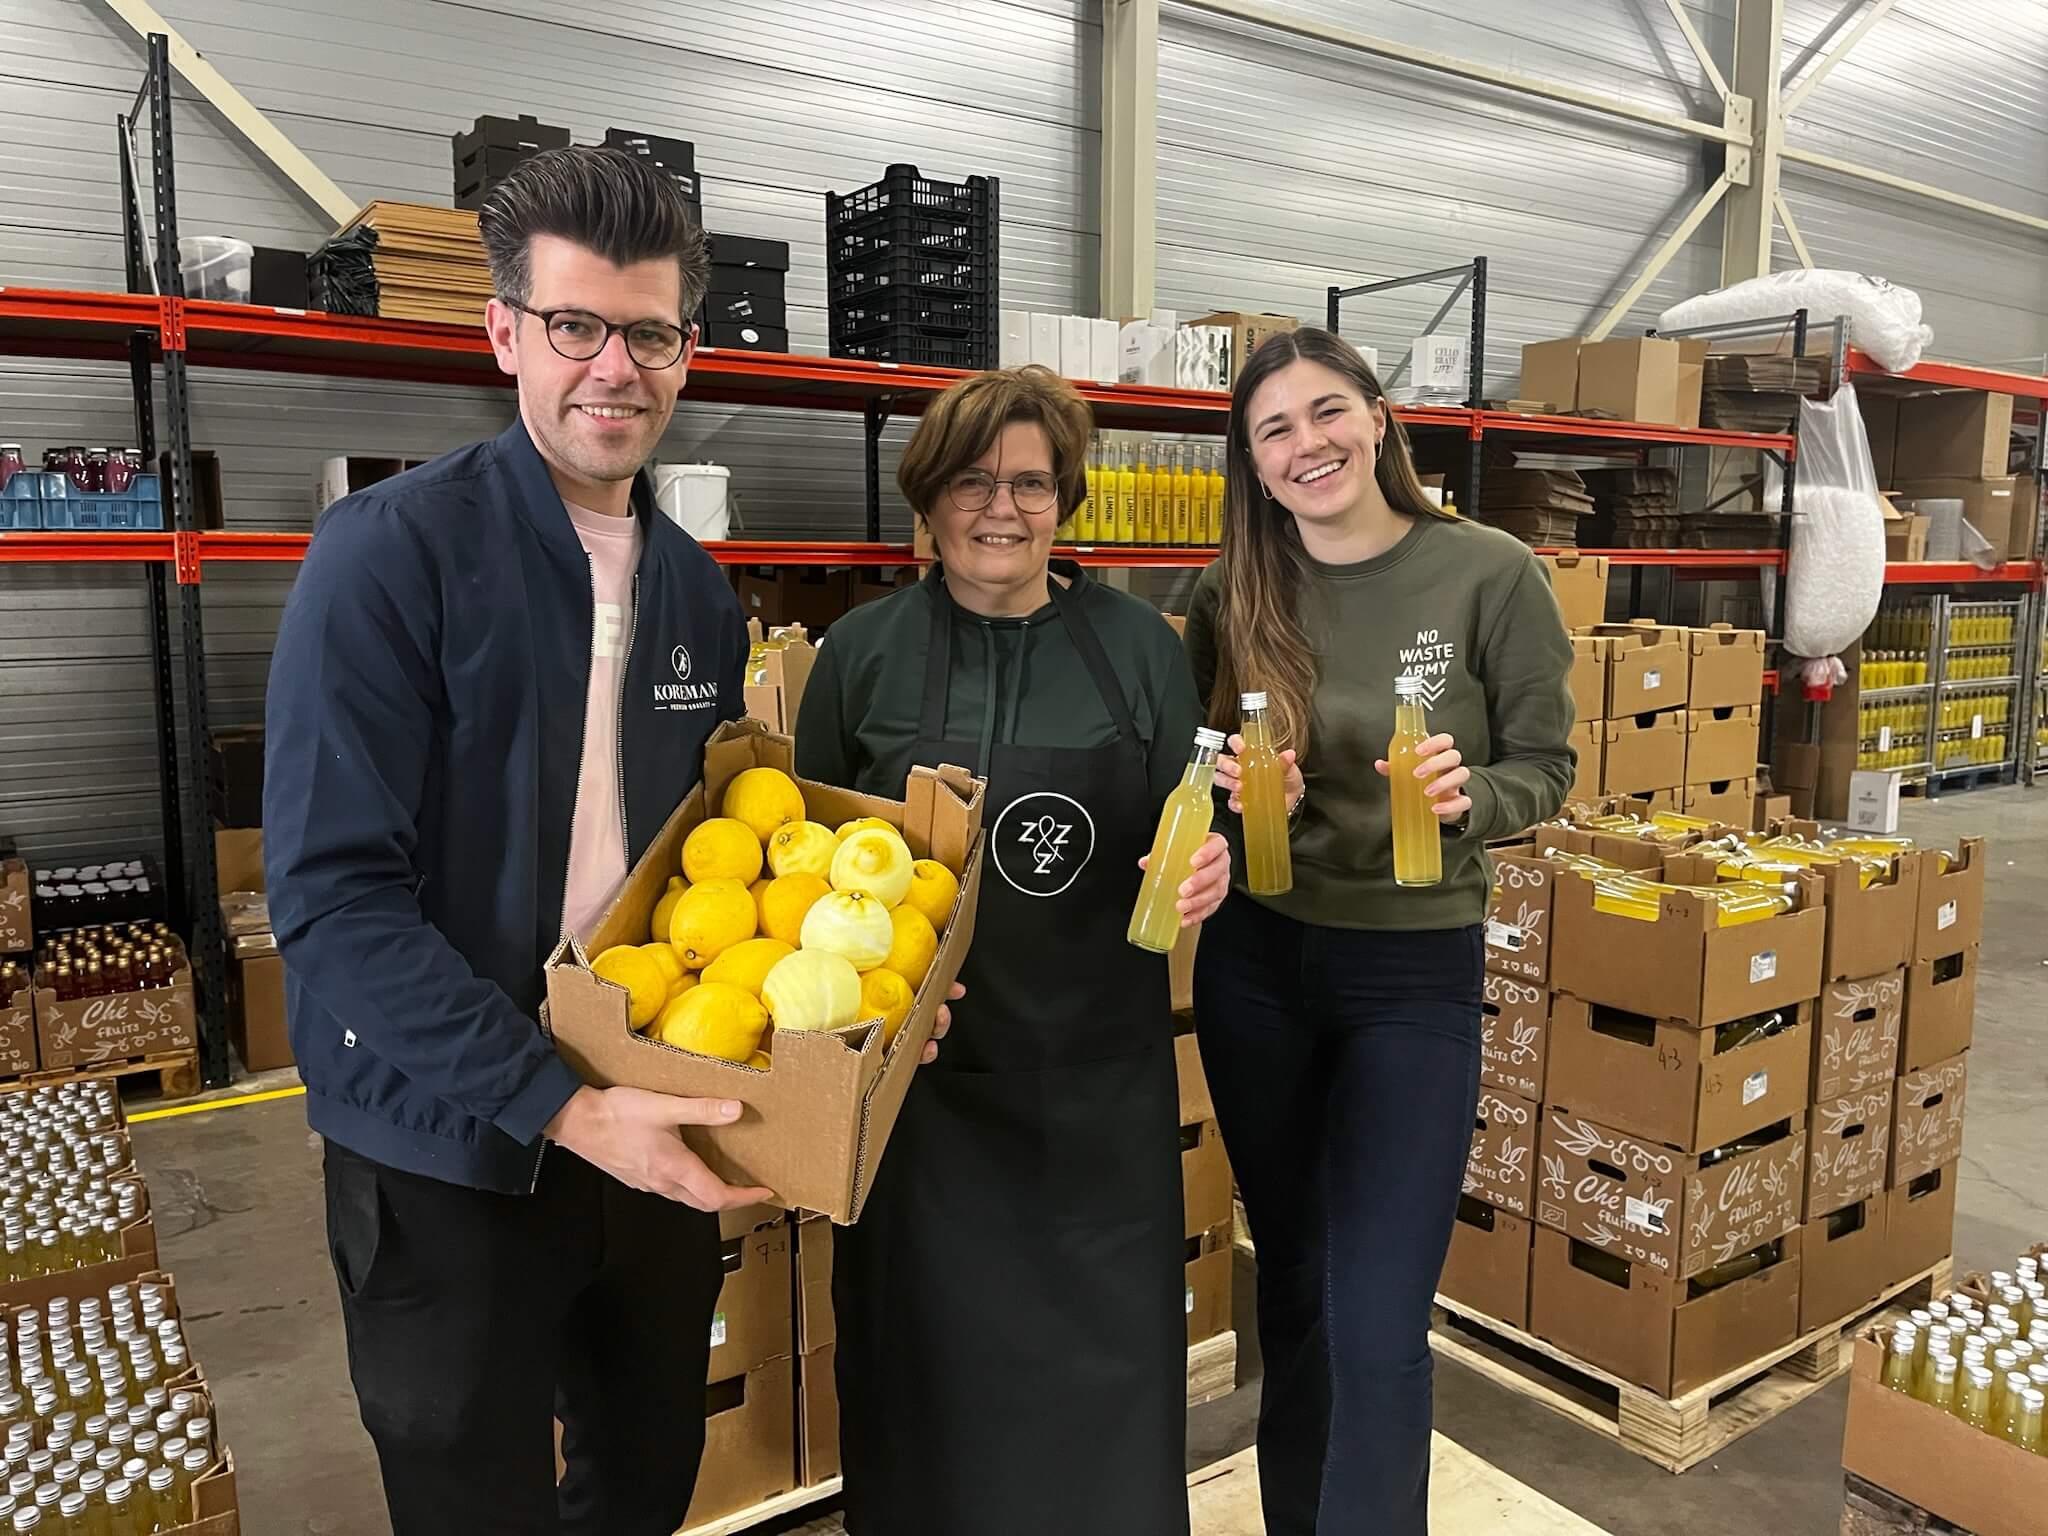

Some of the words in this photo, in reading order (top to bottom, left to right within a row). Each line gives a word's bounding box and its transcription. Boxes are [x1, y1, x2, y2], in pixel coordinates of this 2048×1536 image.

[1416, 629, 1438, 645] NO
[1399, 643, 1455, 663] WASTE
[1402, 660, 1450, 676] ARMY
[653, 681, 719, 701] KOREMAN
[79, 997, 130, 1030] Ché
[1658, 1045, 1682, 1071] 4-3
[1573, 1175, 1624, 1210] Ché
[1719, 1159, 1760, 1212] Ché
